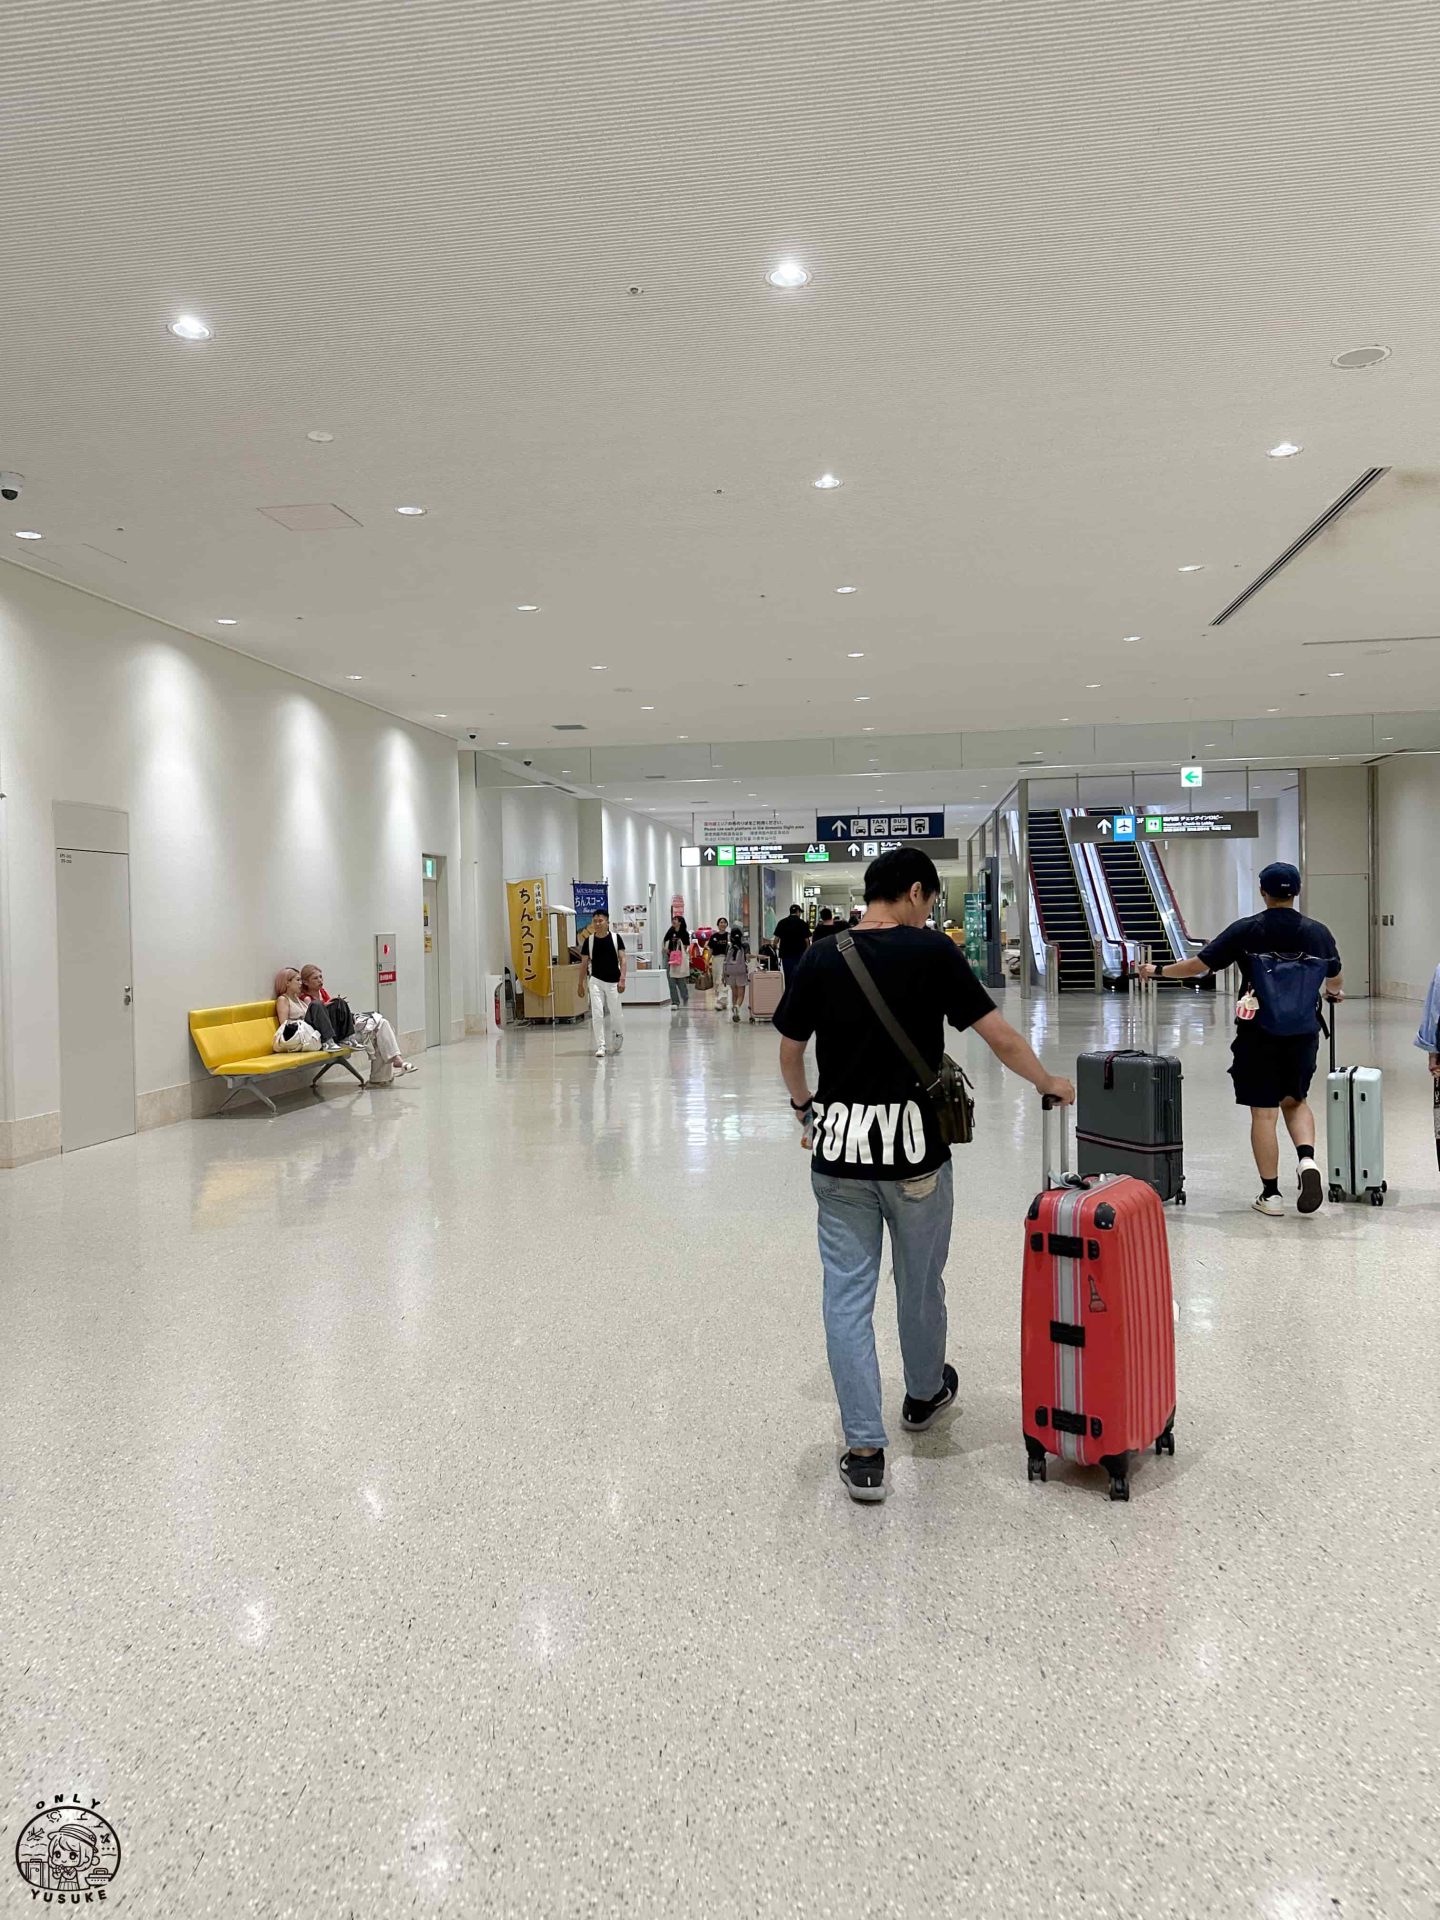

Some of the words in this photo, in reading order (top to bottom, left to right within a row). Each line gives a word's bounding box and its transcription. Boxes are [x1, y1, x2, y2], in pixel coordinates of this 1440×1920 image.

[519, 888, 537, 981] ちんスコーン
[575, 896, 605, 907] ちんスコーン
[812, 1099, 926, 1165] TOKYO
